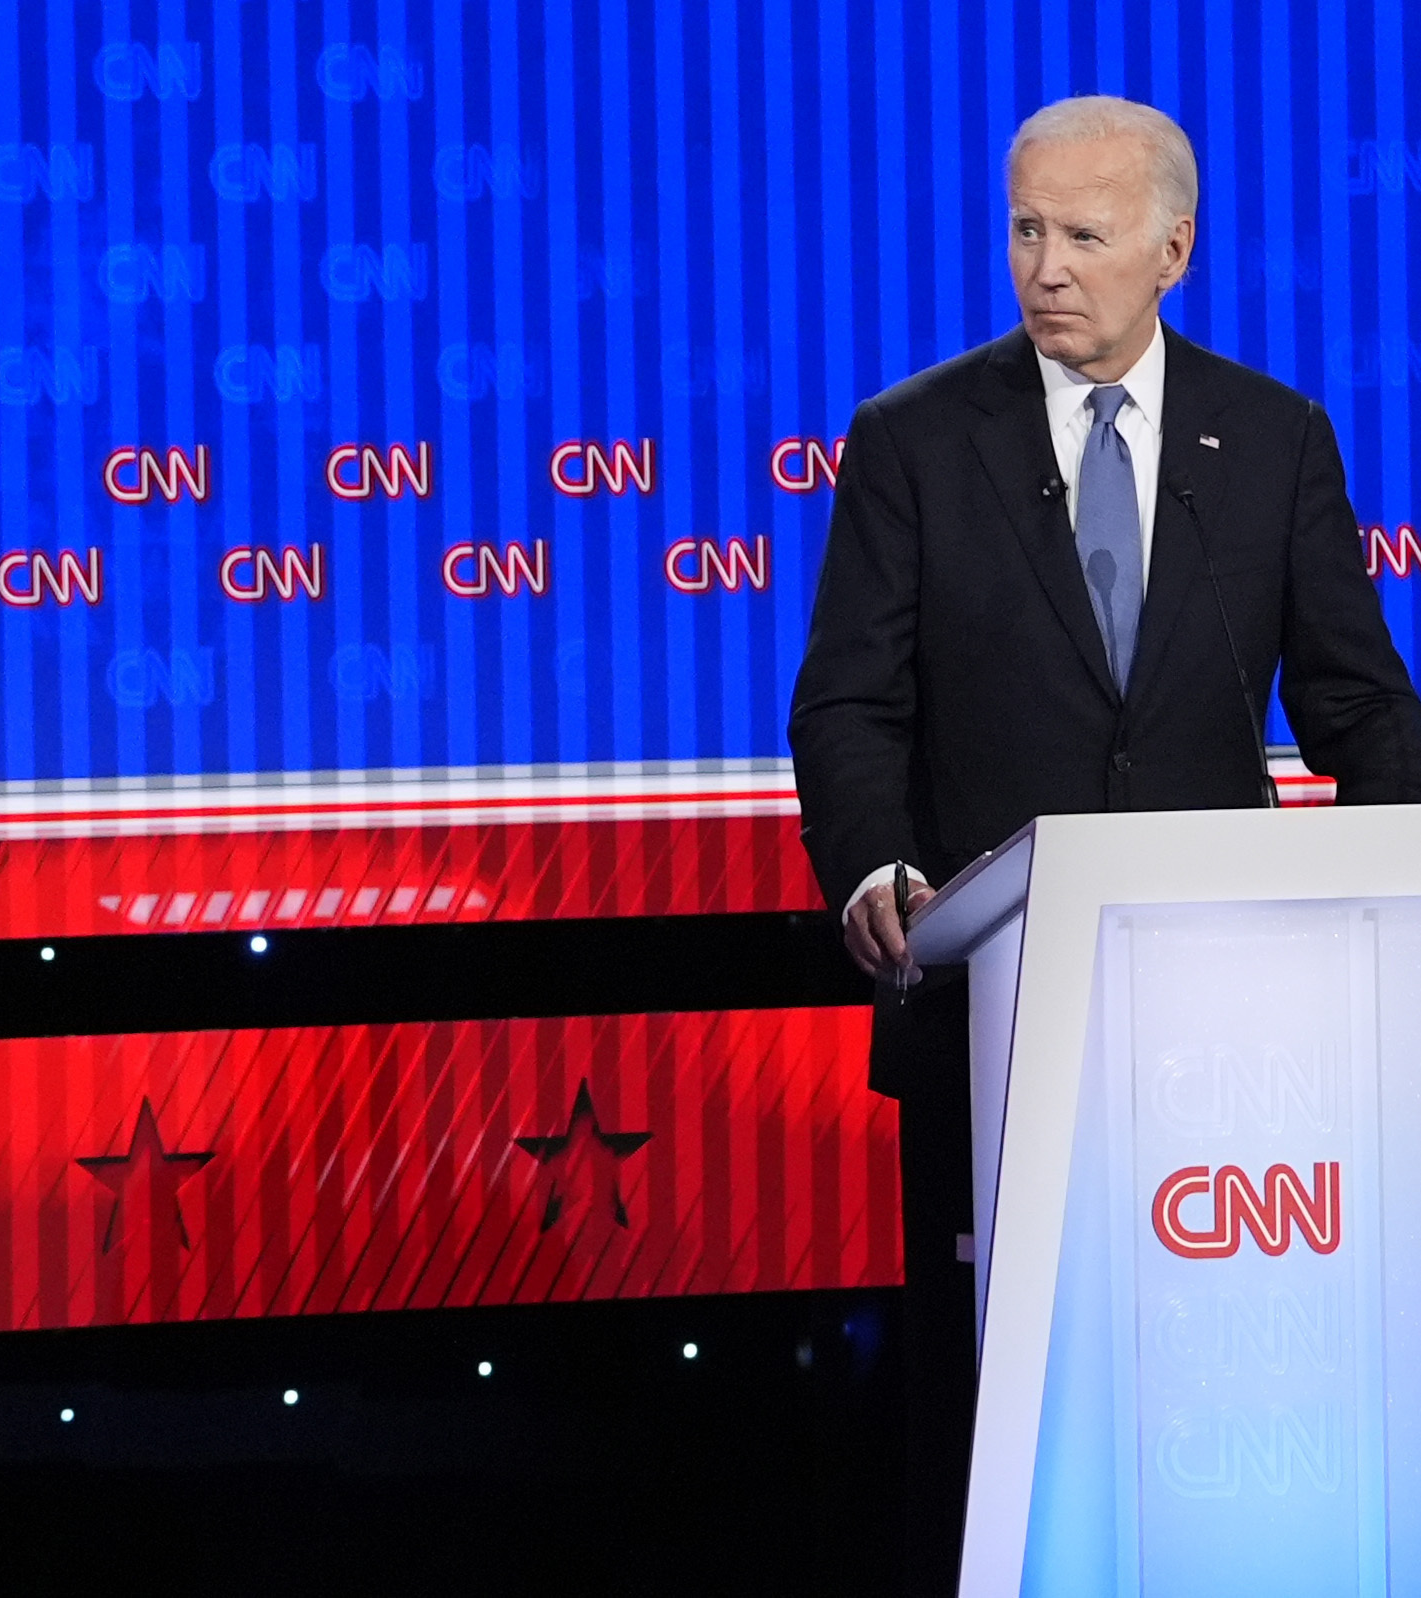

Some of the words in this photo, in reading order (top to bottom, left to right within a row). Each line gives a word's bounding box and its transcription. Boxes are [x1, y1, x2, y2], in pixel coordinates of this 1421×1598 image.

[209, 143, 318, 203] CNN
[98, 243, 205, 304] CNN
[320, 243, 428, 303] CNN
[214, 344, 323, 405] CNN
[103, 444, 209, 505] CNN
[325, 440, 431, 501] CNN
[549, 437, 654, 498] CNN
[220, 542, 325, 603] CNN
[442, 538, 548, 599] CNN
[664, 534, 770, 594] CNN
[1152, 1161, 1340, 1259] CNN
